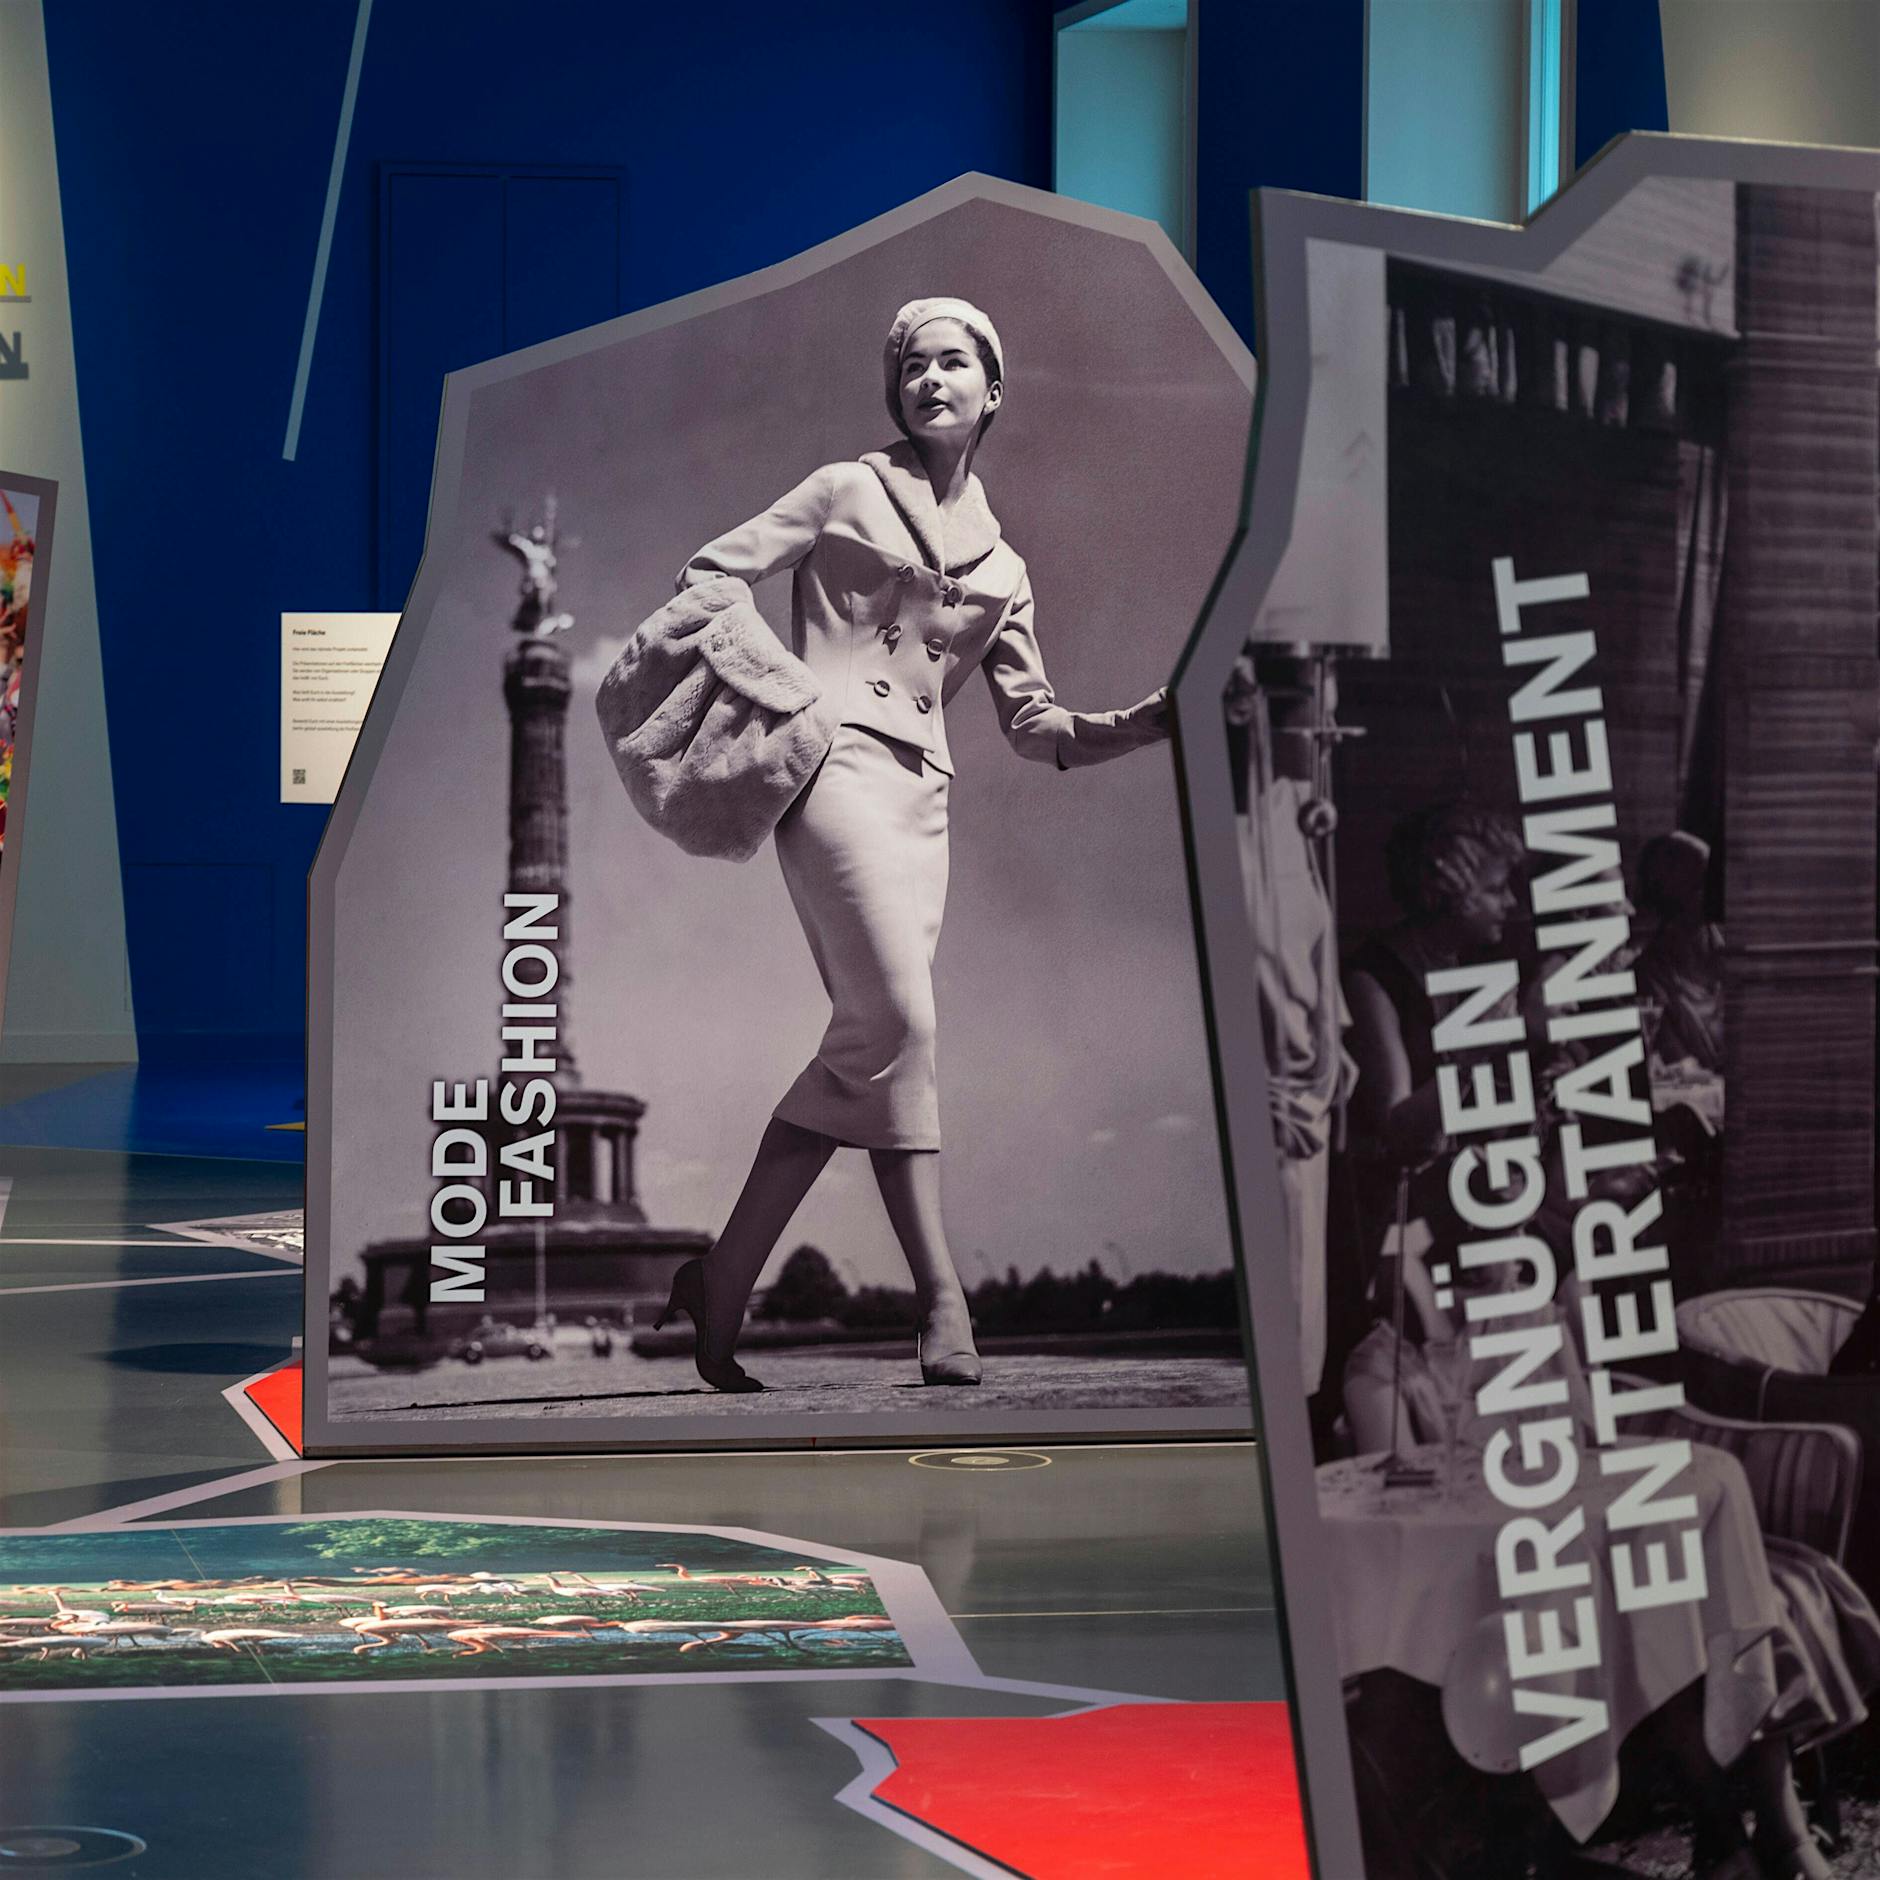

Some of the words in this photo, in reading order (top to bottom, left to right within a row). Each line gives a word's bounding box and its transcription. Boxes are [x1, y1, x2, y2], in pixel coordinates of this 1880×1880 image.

[430, 1079, 488, 1303] MODE
[499, 893, 559, 1217] FASHION
[1491, 556, 1708, 1612] ENTERTAINMENT
[1425, 959, 1610, 1772] VERGNÜGEN
